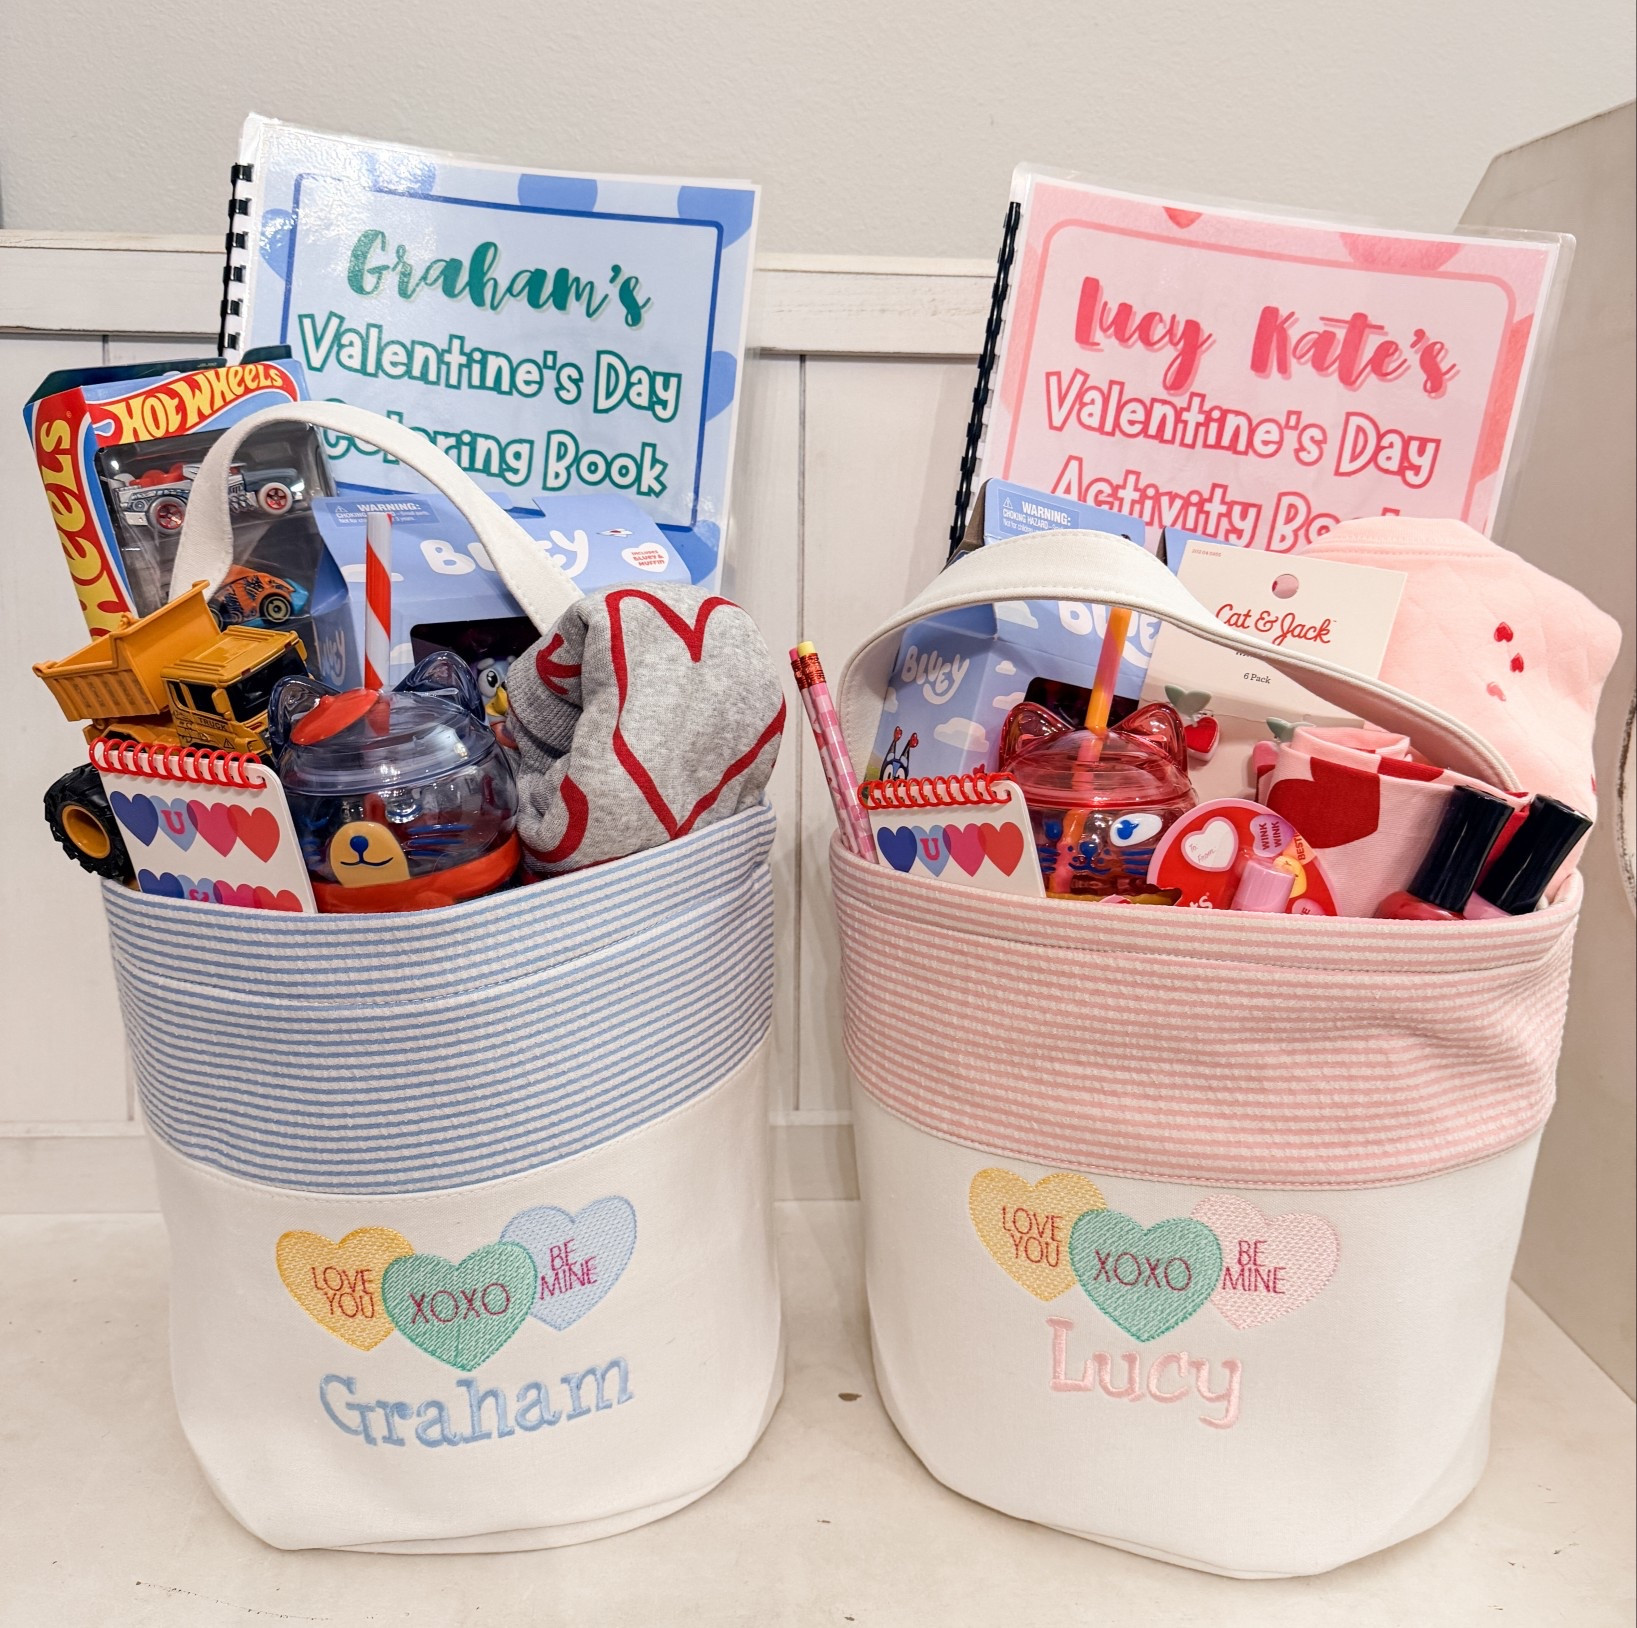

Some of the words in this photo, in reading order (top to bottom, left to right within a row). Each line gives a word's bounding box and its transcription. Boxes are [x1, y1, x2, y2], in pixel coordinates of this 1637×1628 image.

[347, 229, 652, 327] Graham's
[1075, 276, 1213, 393] Lucy
[1250, 306, 1460, 398] Kate's
[298, 311, 584, 404] Valentine's
[593, 349, 682, 422] Day
[1045, 368, 1328, 467] Valentine's
[1333, 411, 1441, 489] Day
[321, 398, 534, 486] Clring
[542, 430, 668, 497] Book
[357, 502, 421, 512] WARNING:
[1002, 508, 1026, 523] CHOKING
[1022, 501, 1071, 527] WARNING:
[1050, 454, 1262, 547] Activity
[1266, 491, 1401, 553] Bo
[1215, 603, 1251, 630] Cat
[1254, 610, 1279, 632] &
[1272, 612, 1331, 646] Jack
[1243, 672, 1250, 680] 6
[1250, 673, 1271, 684] Pack
[161, 809, 186, 835] U
[1259, 822, 1270, 851] WINK
[1271, 821, 1282, 848] WINK
[920, 838, 940, 861] U
[1001, 1205, 1062, 1242] LOVE
[548, 1238, 576, 1271] BE
[1010, 1235, 1060, 1268] YOU
[1237, 1239, 1267, 1266] BE
[310, 1265, 375, 1295] LOVE
[538, 1256, 598, 1300] MINE
[1092, 1248, 1192, 1292] XOXO
[1221, 1265, 1287, 1295] MINE
[323, 1291, 375, 1319] YOU
[409, 1282, 511, 1325] XOXO
[1046, 1315, 1243, 1430] Lucy
[319, 1356, 635, 1448] Graham
